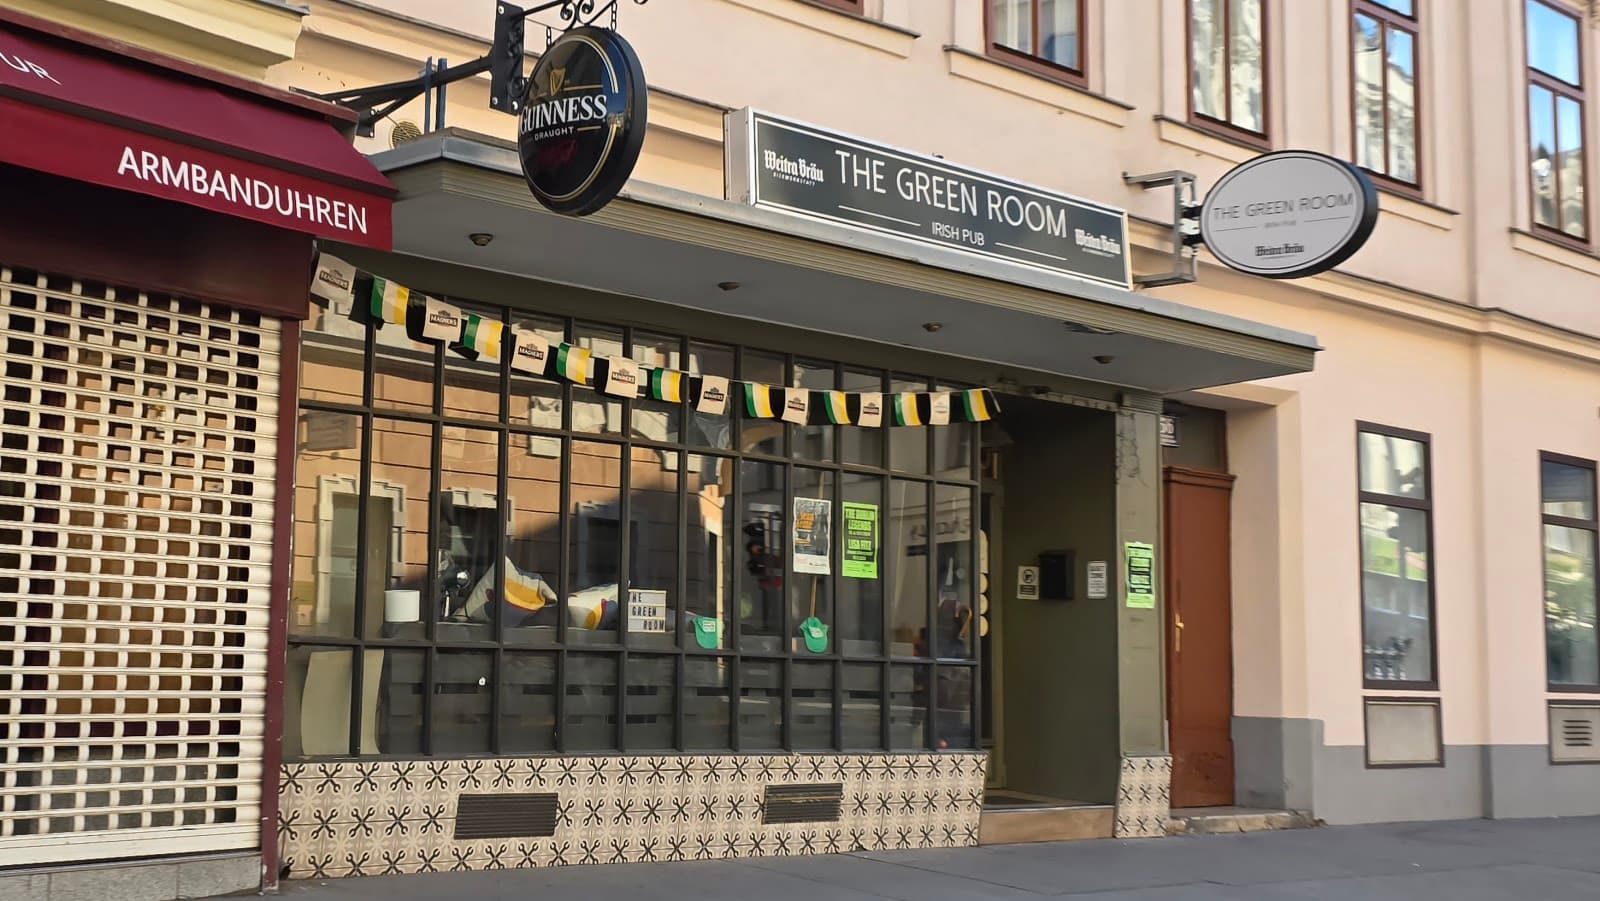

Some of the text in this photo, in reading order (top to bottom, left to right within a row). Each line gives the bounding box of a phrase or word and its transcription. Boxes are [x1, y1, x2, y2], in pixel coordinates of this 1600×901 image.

[520, 94, 607, 134] GUINNESS
[534, 126, 574, 142] DRAUGHT
[763, 149, 825, 183] Weitra Bräu
[117, 146, 367, 235] ARMBANDUHREN
[834, 150, 1067, 239] THE GREEN ROOM
[1213, 193, 1353, 219] THE GREEN ROOM
[931, 221, 985, 246] IRISH PUB
[431, 314, 457, 327] MAGNERS
[632, 606, 657, 617] GREEN
[643, 619, 664, 631] ROOM
